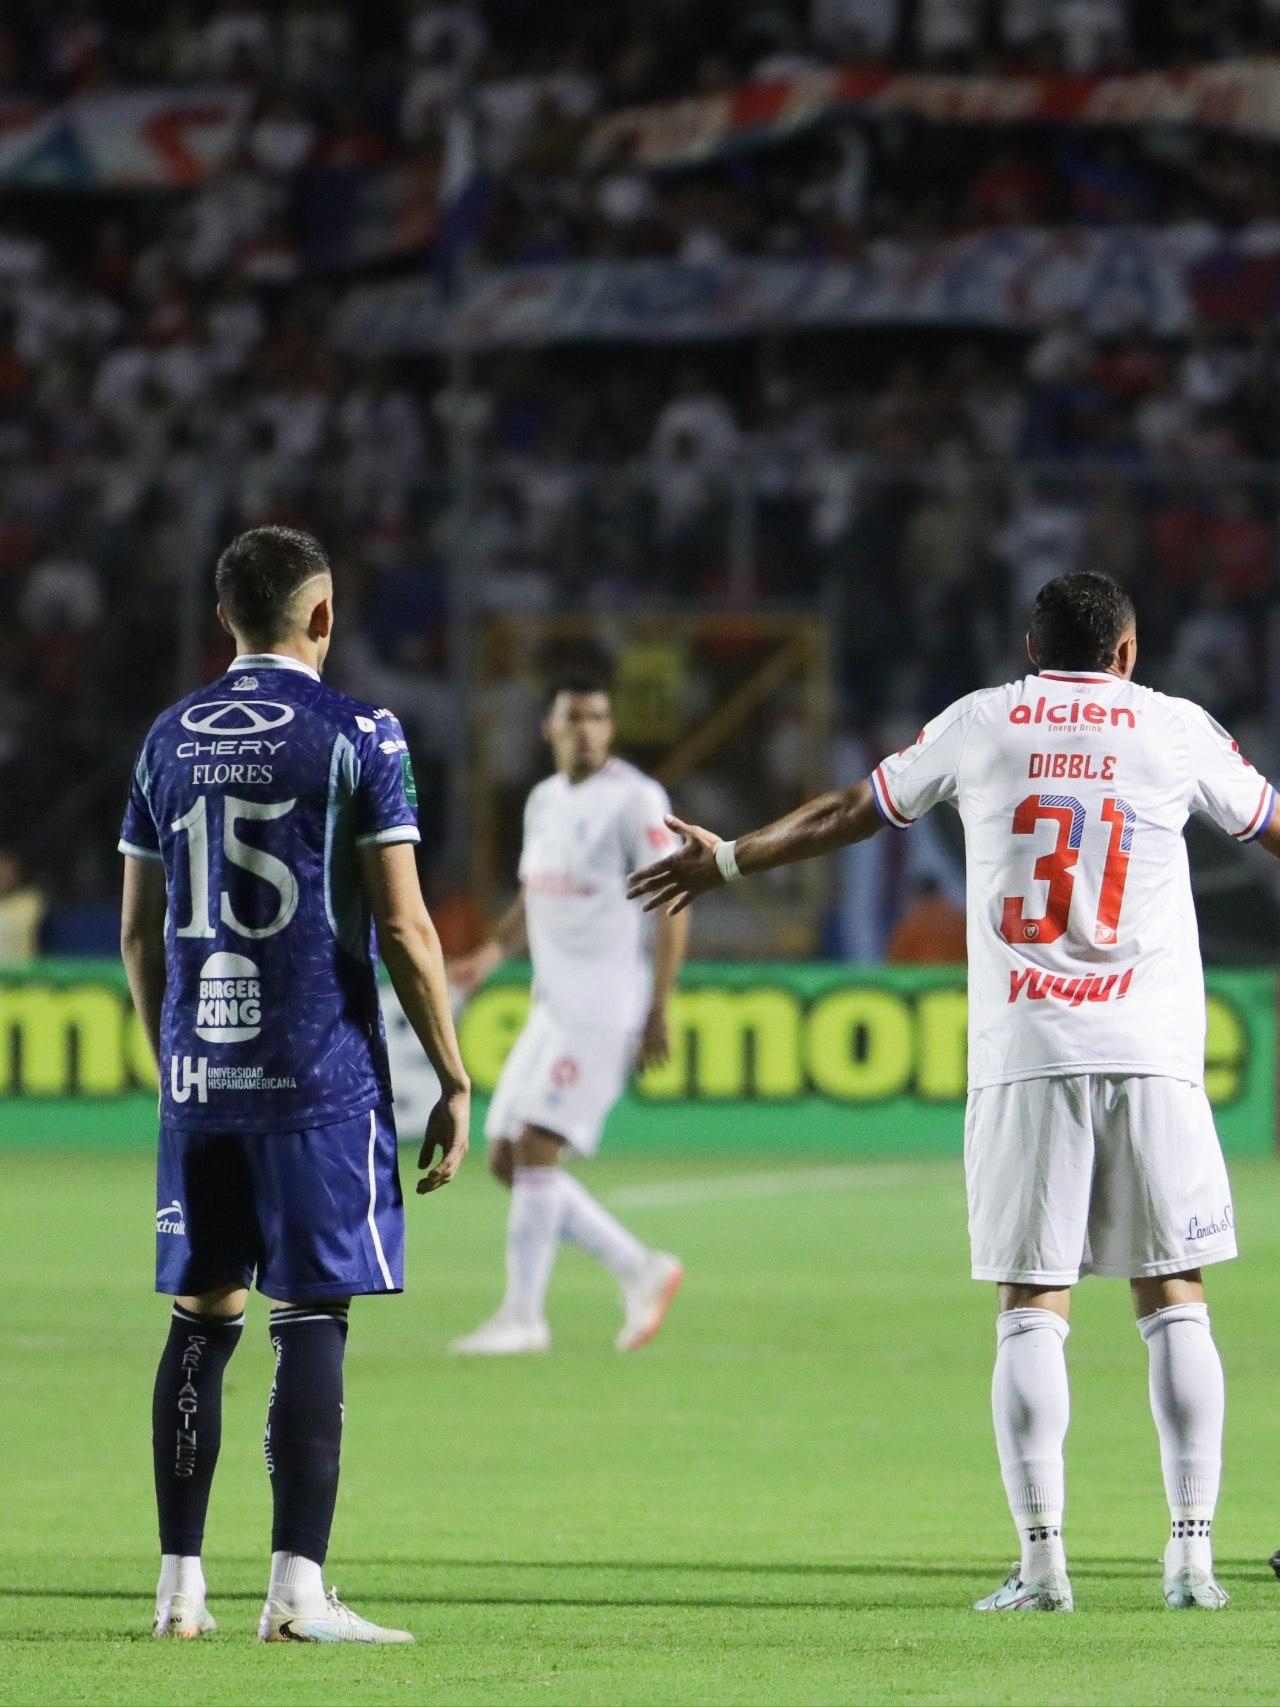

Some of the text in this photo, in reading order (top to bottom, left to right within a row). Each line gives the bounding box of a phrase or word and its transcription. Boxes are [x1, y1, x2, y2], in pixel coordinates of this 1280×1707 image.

[1009, 696, 1136, 729] alcien
[1048, 724, 1103, 734] Energy Drink
[176, 741, 286, 758] CHERY
[192, 764, 273, 785] FLORES
[1028, 753, 1117, 781] DIBBLE
[170, 795, 299, 940] 15
[1000, 794, 1137, 945] 31
[200, 980, 261, 999] BURGER
[197, 1000, 261, 1027] KING
[208, 1067, 264, 1079] UNIVERSIDAD
[208, 1078, 297, 1090] HISPANOAMERICANA
